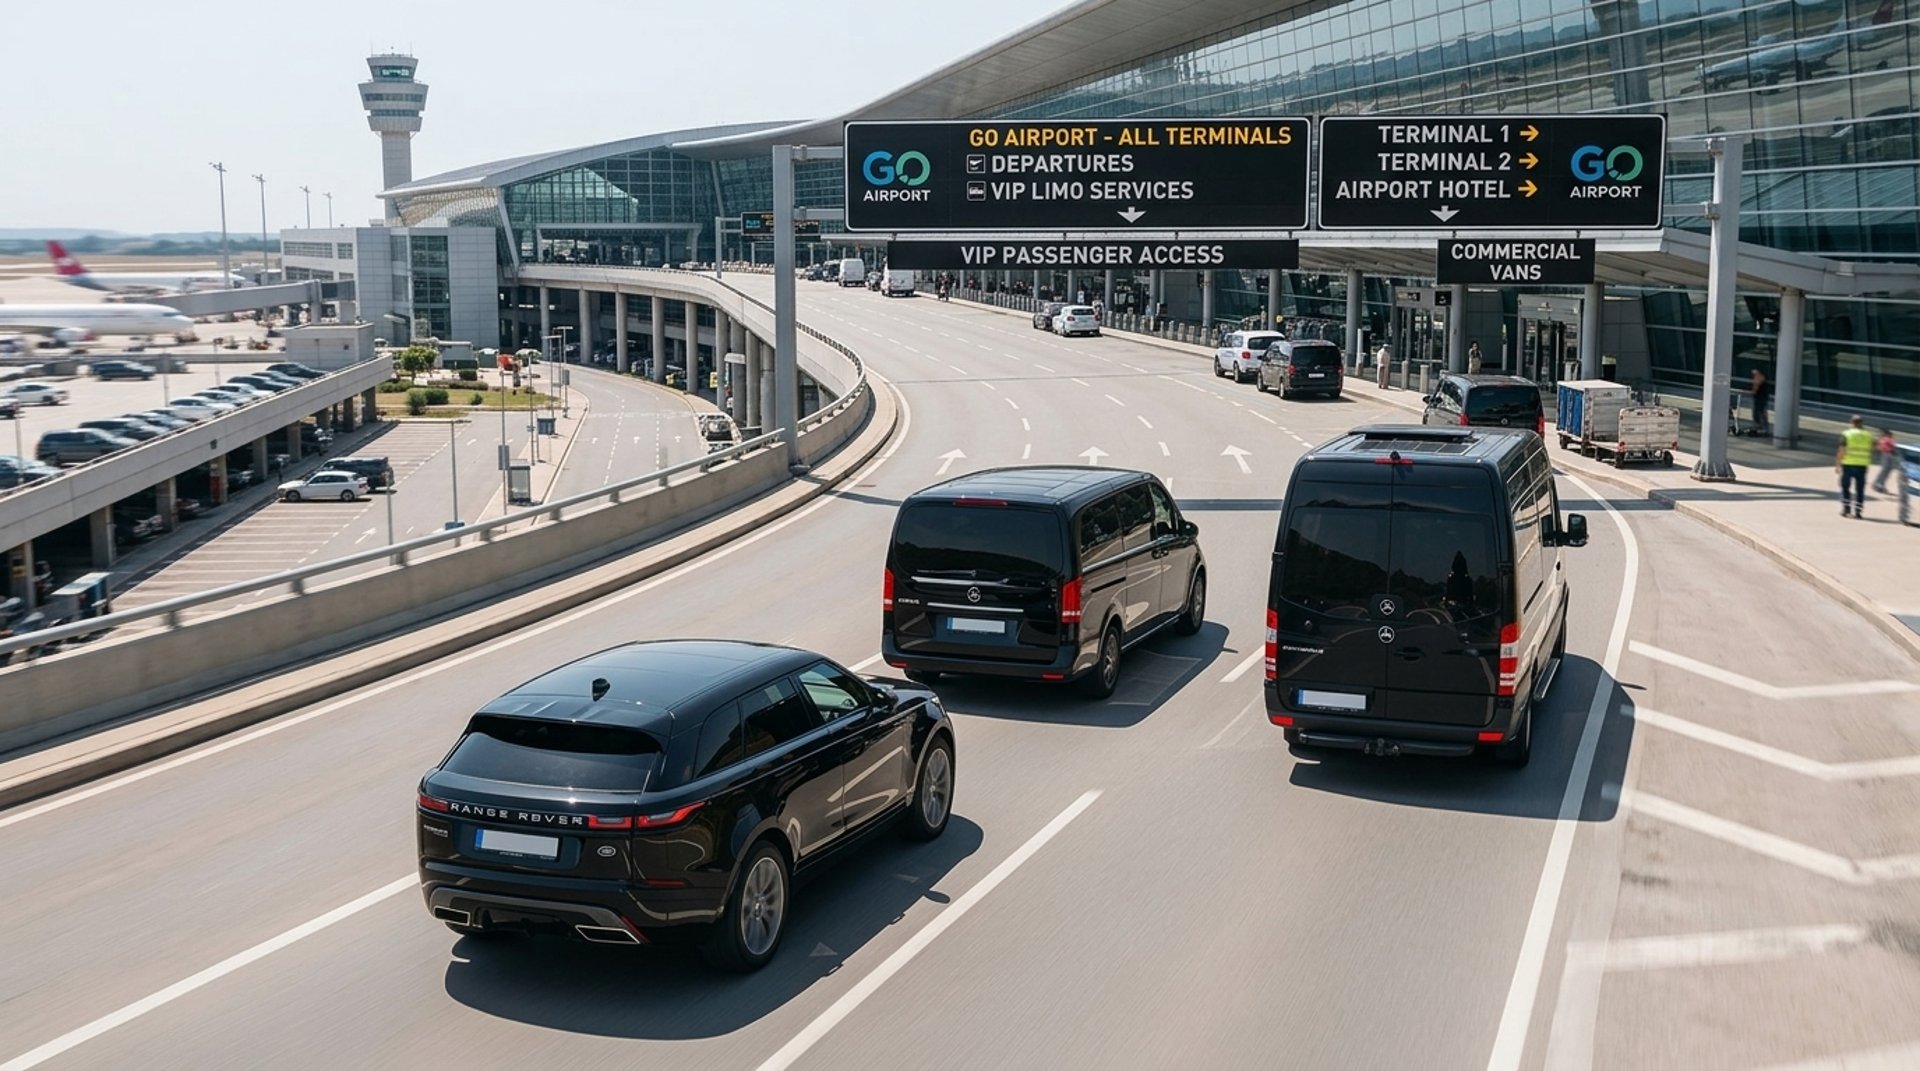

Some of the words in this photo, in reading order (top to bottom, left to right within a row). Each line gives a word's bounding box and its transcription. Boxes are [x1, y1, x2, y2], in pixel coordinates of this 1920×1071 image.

[969, 128, 999, 147] GO
[1004, 128, 1098, 147] AIRPORT
[1118, 127, 1160, 146] ALL
[1165, 126, 1292, 145] TERMINALS
[1378, 125, 1493, 144] TERMINAL
[1500, 124, 1510, 143] 1
[862, 150, 931, 186] GO
[991, 154, 1134, 173] DEPARTURES
[1377, 152, 1493, 171] TERMINAL
[1498, 152, 1511, 171] 2
[1570, 145, 1643, 182] GO
[863, 189, 932, 202] AIRPORT
[990, 181, 1026, 200] VIP
[1031, 181, 1084, 200] LIMO
[1090, 180, 1194, 200] SERVICES
[1335, 180, 1433, 199] AIRPORT
[1439, 180, 1511, 199] HOTEL
[1569, 185, 1643, 198] AIRPORT
[960, 245, 997, 265] VIP
[1002, 245, 1133, 265] PASSENGER
[1138, 244, 1225, 264] ACCESS
[1451, 243, 1581, 260] COMMERCIAL
[1489, 264, 1542, 281] VANS
